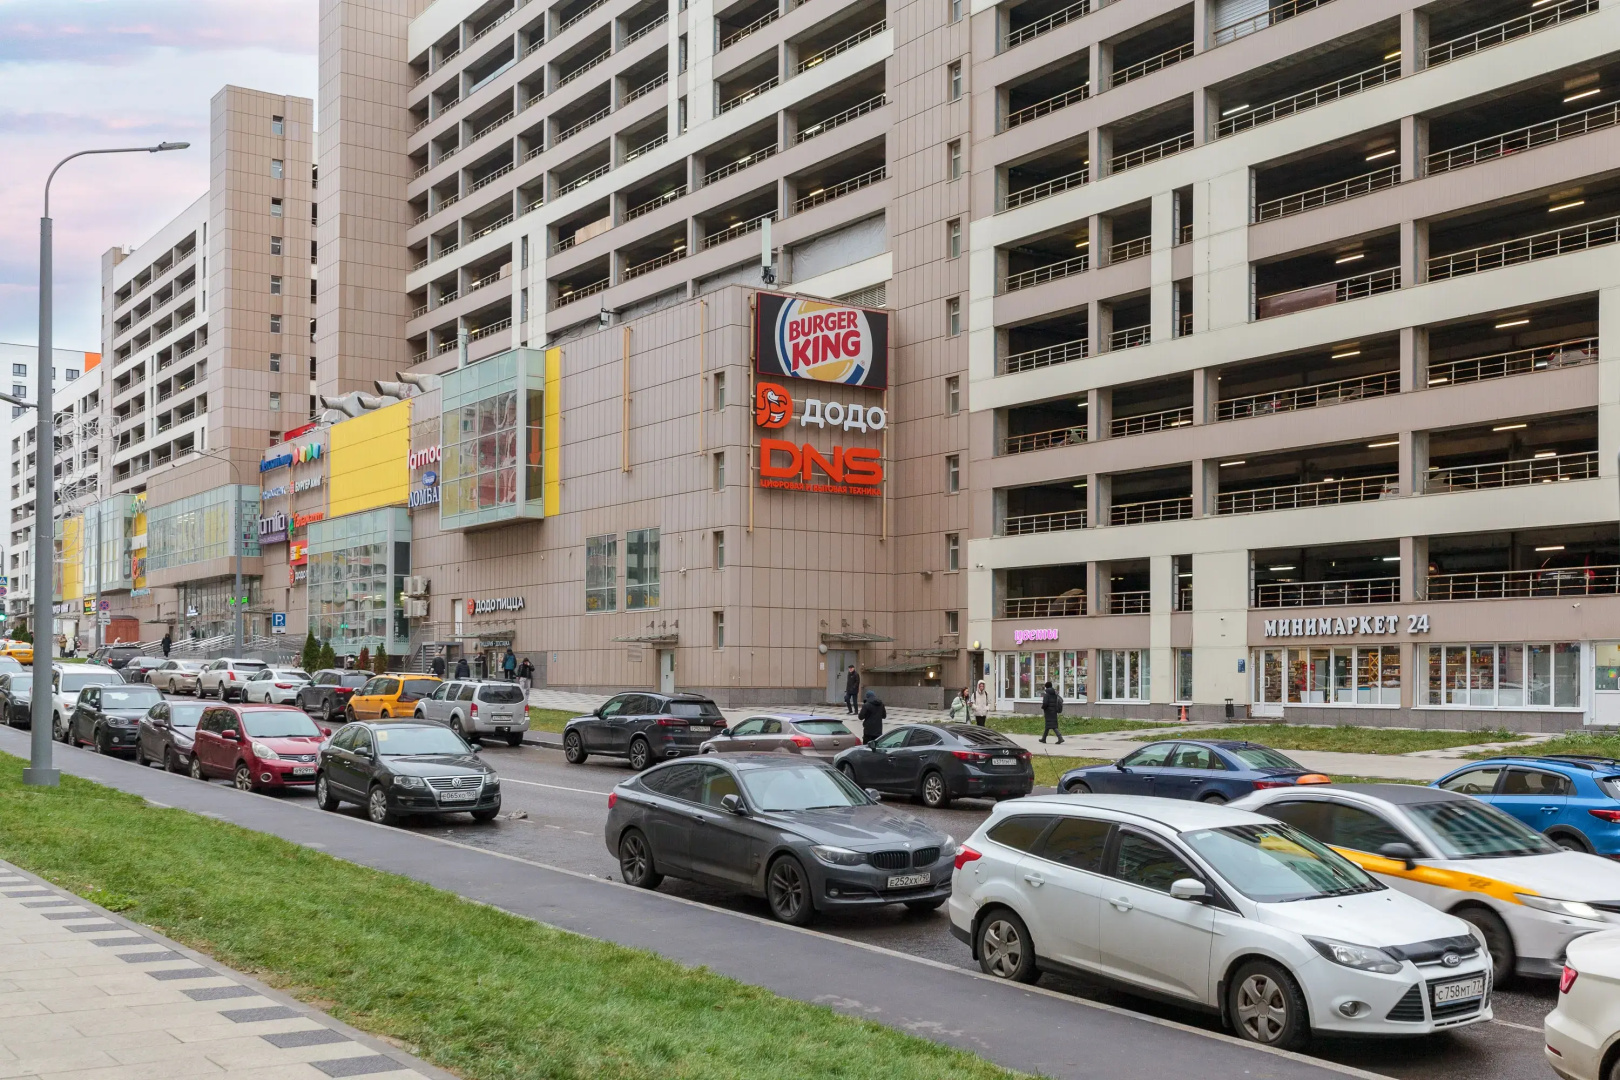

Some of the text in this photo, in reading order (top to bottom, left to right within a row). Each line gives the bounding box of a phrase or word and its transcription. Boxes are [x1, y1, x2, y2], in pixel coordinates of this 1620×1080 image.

[788, 310, 859, 342] BURGER
[791, 329, 861, 372] KING
[800, 398, 886, 434] ДОДО
[760, 437, 884, 486] DNS
[408, 486, 440, 507] ЛОМБА
[760, 479, 882, 496] ЦИФРОВАЯ И БЫТОВАЯ ТЕХНИКА
[475, 596, 524, 614] ДОДО ПИЦЦА
[1264, 614, 1430, 637] МИНИМАРКЕТ 24
